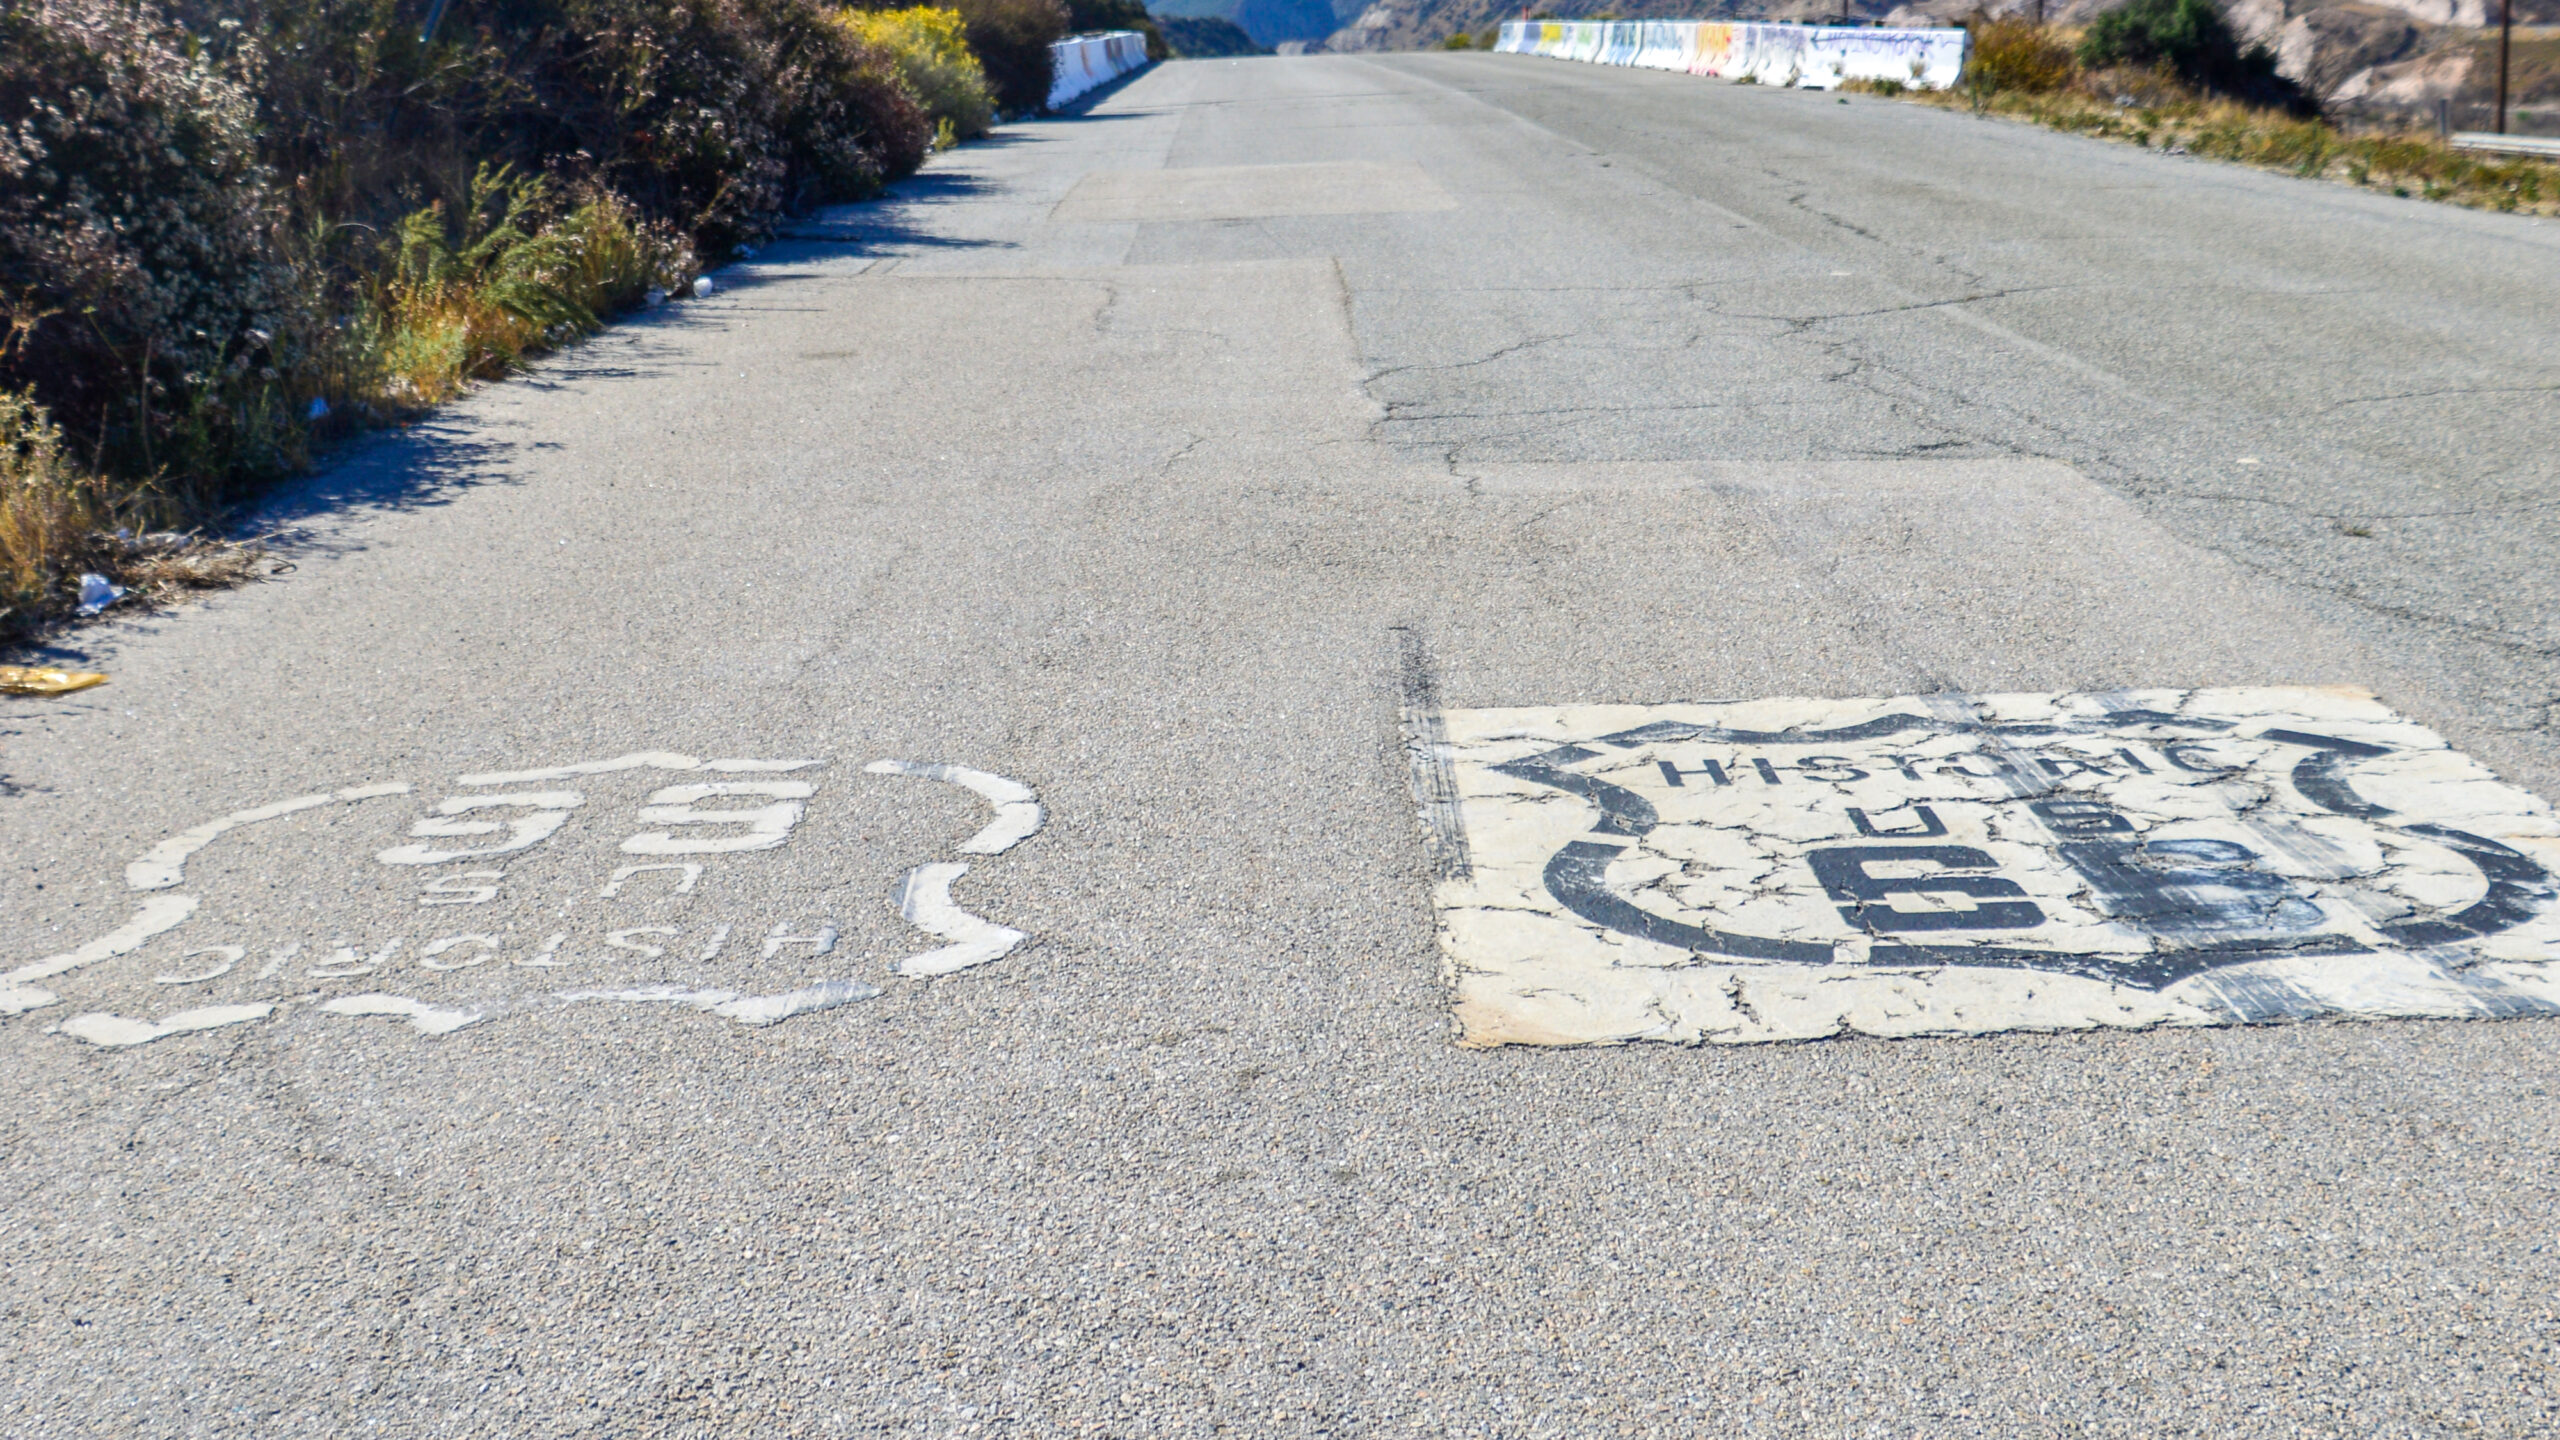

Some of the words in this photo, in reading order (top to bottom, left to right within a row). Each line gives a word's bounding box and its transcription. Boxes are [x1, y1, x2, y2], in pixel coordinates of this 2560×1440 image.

[1656, 745, 2242, 788] HISTORIC
[375, 780, 819, 866] 66
[153, 921, 839, 984] HISTORIC
